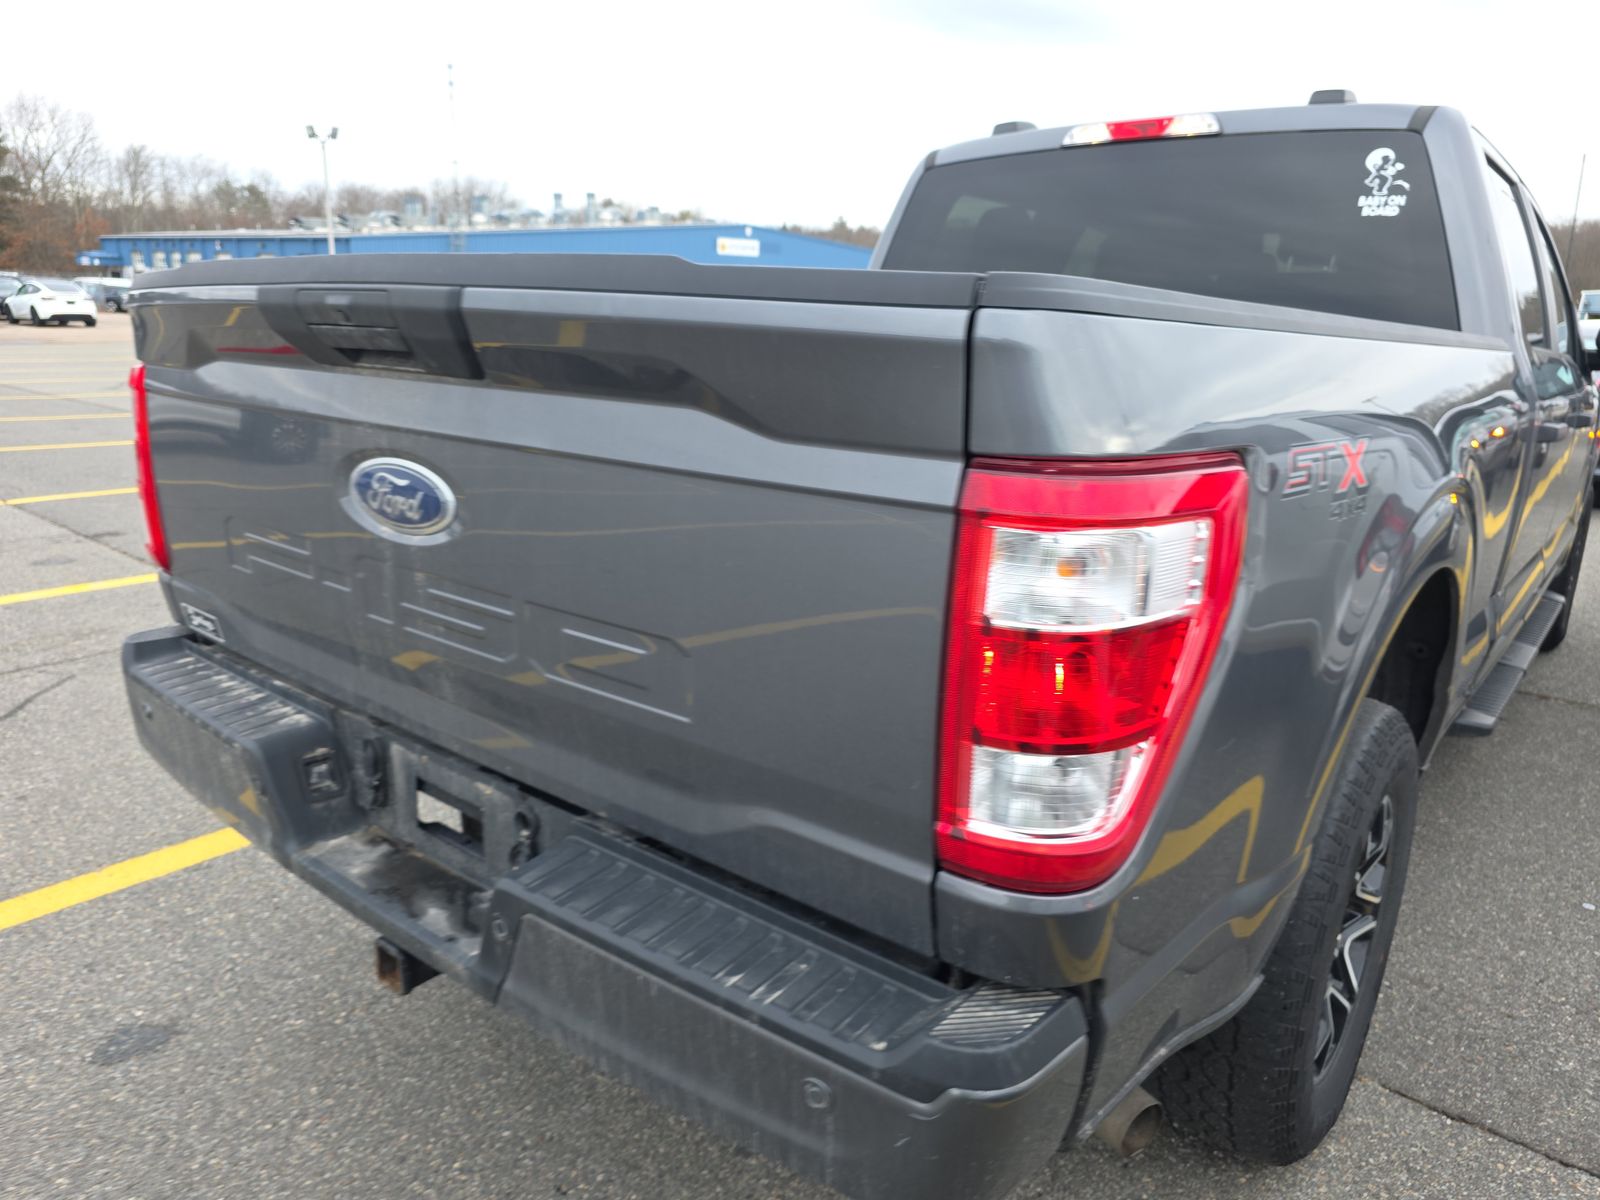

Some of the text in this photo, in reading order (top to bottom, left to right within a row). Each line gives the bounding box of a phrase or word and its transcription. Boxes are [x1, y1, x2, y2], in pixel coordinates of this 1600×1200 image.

[1358, 195, 1407, 207] BABY ON
[1361, 206, 1400, 217] BOARD
[1281, 438, 1369, 494] STX
[366, 471, 425, 521] Ford
